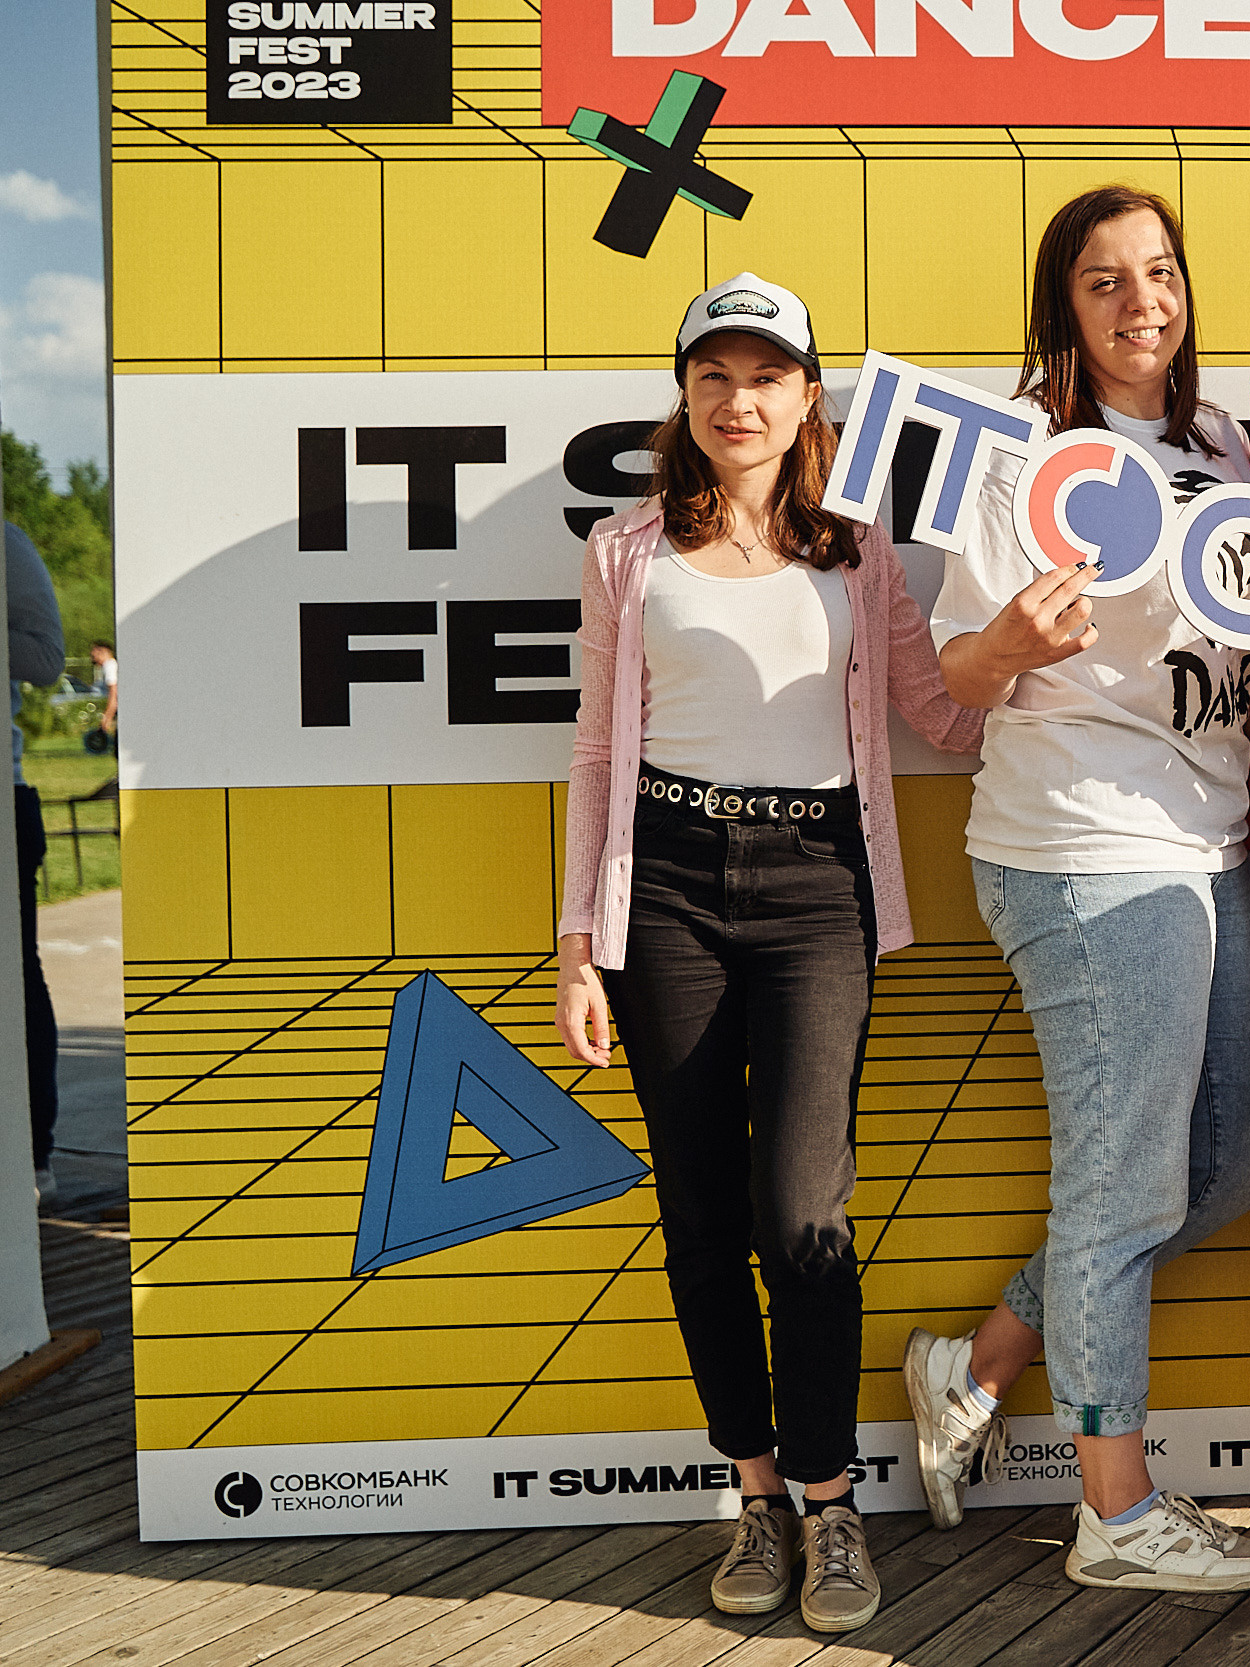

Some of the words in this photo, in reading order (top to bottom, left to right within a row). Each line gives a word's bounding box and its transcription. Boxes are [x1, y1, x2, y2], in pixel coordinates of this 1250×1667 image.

[228, 2, 435, 30] SUMMER
[228, 37, 352, 64] FEST
[228, 71, 361, 99] 2023
[298, 426, 507, 552] IT
[299, 598, 582, 728] FE
[270, 1469, 449, 1493] СОВКОМБАНК
[493, 1470, 538, 1498] IT
[272, 1493, 403, 1511] ТЕХНОЛОГИИ
